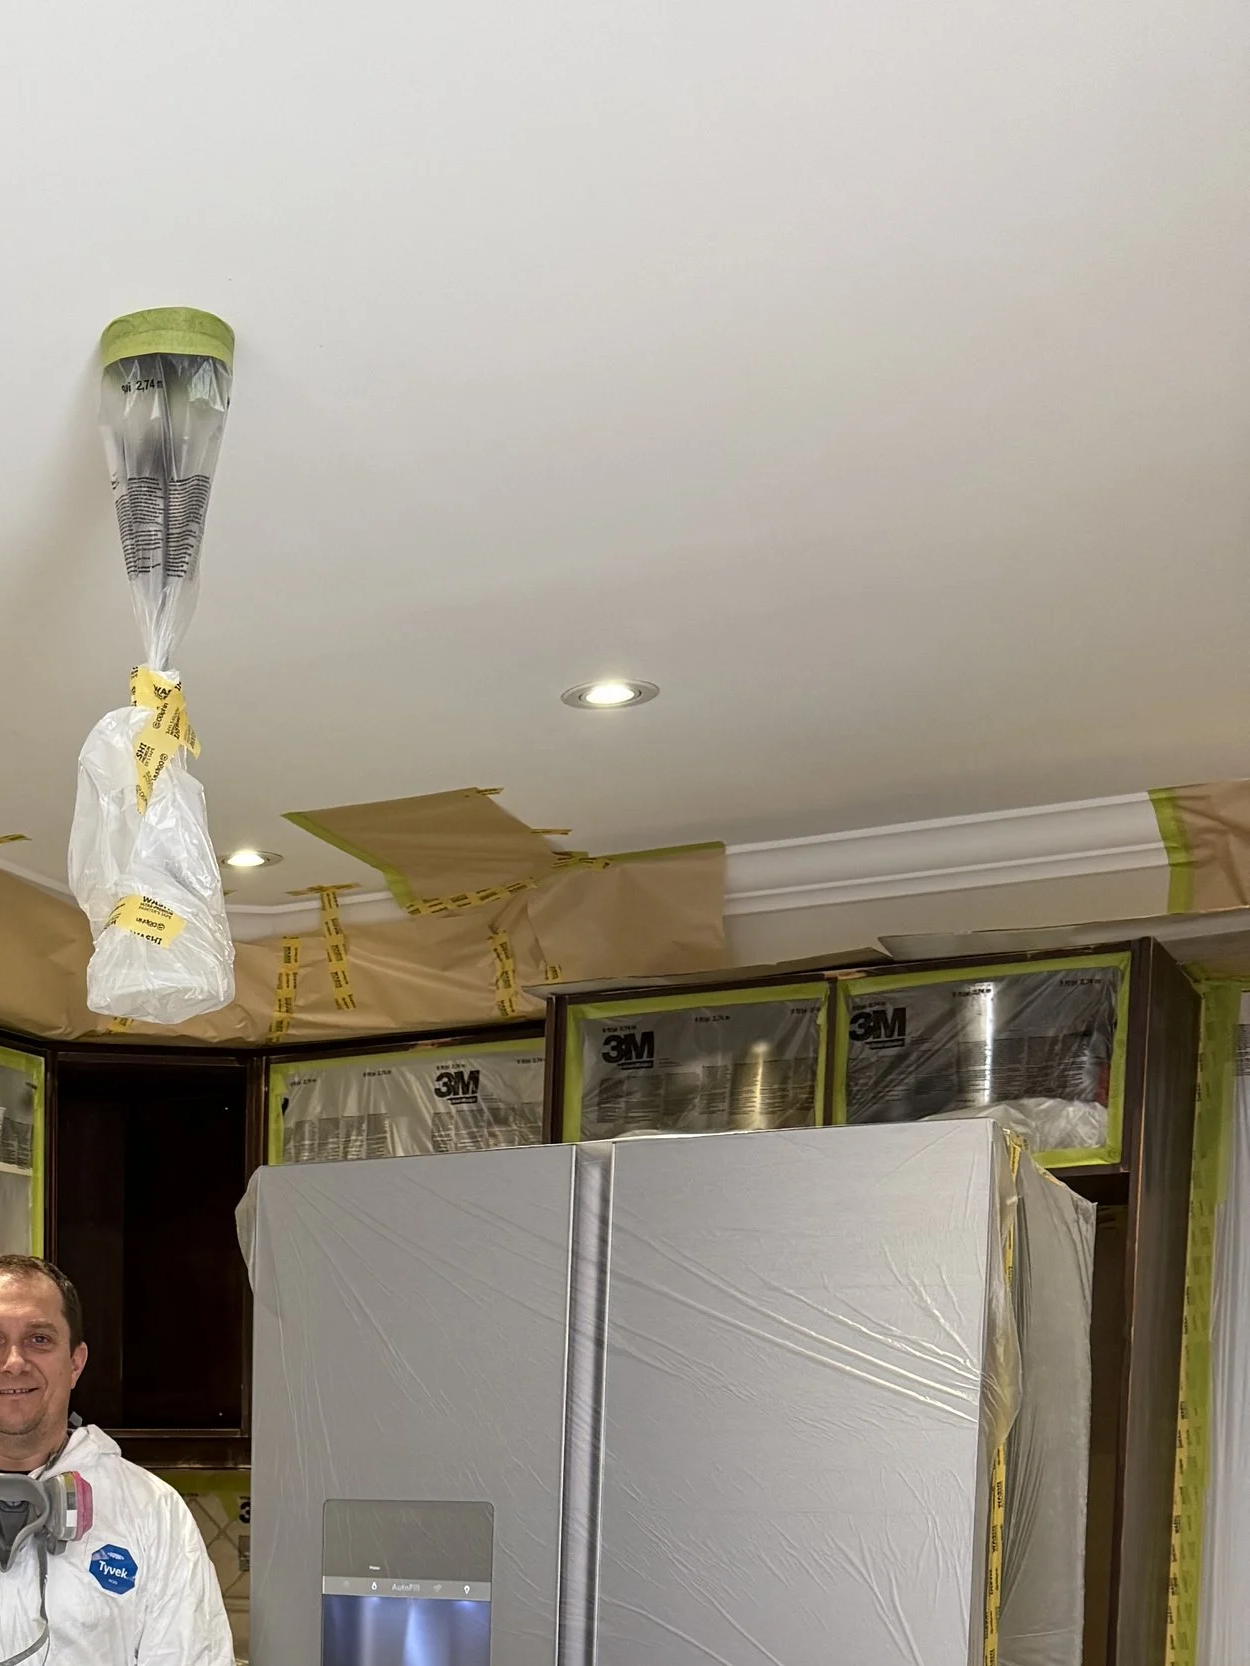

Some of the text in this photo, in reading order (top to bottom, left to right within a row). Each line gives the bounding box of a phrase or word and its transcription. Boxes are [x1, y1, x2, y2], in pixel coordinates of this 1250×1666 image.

[136, 378, 155, 392] 2,74
[136, 742, 147, 760] SHI
[849, 1007, 906, 1042] 3M
[602, 1031, 655, 1064] 3M
[434, 1070, 480, 1098] 3M
[99, 1561, 128, 1579] Tyvek
[391, 1584, 421, 1592] AutoFill
